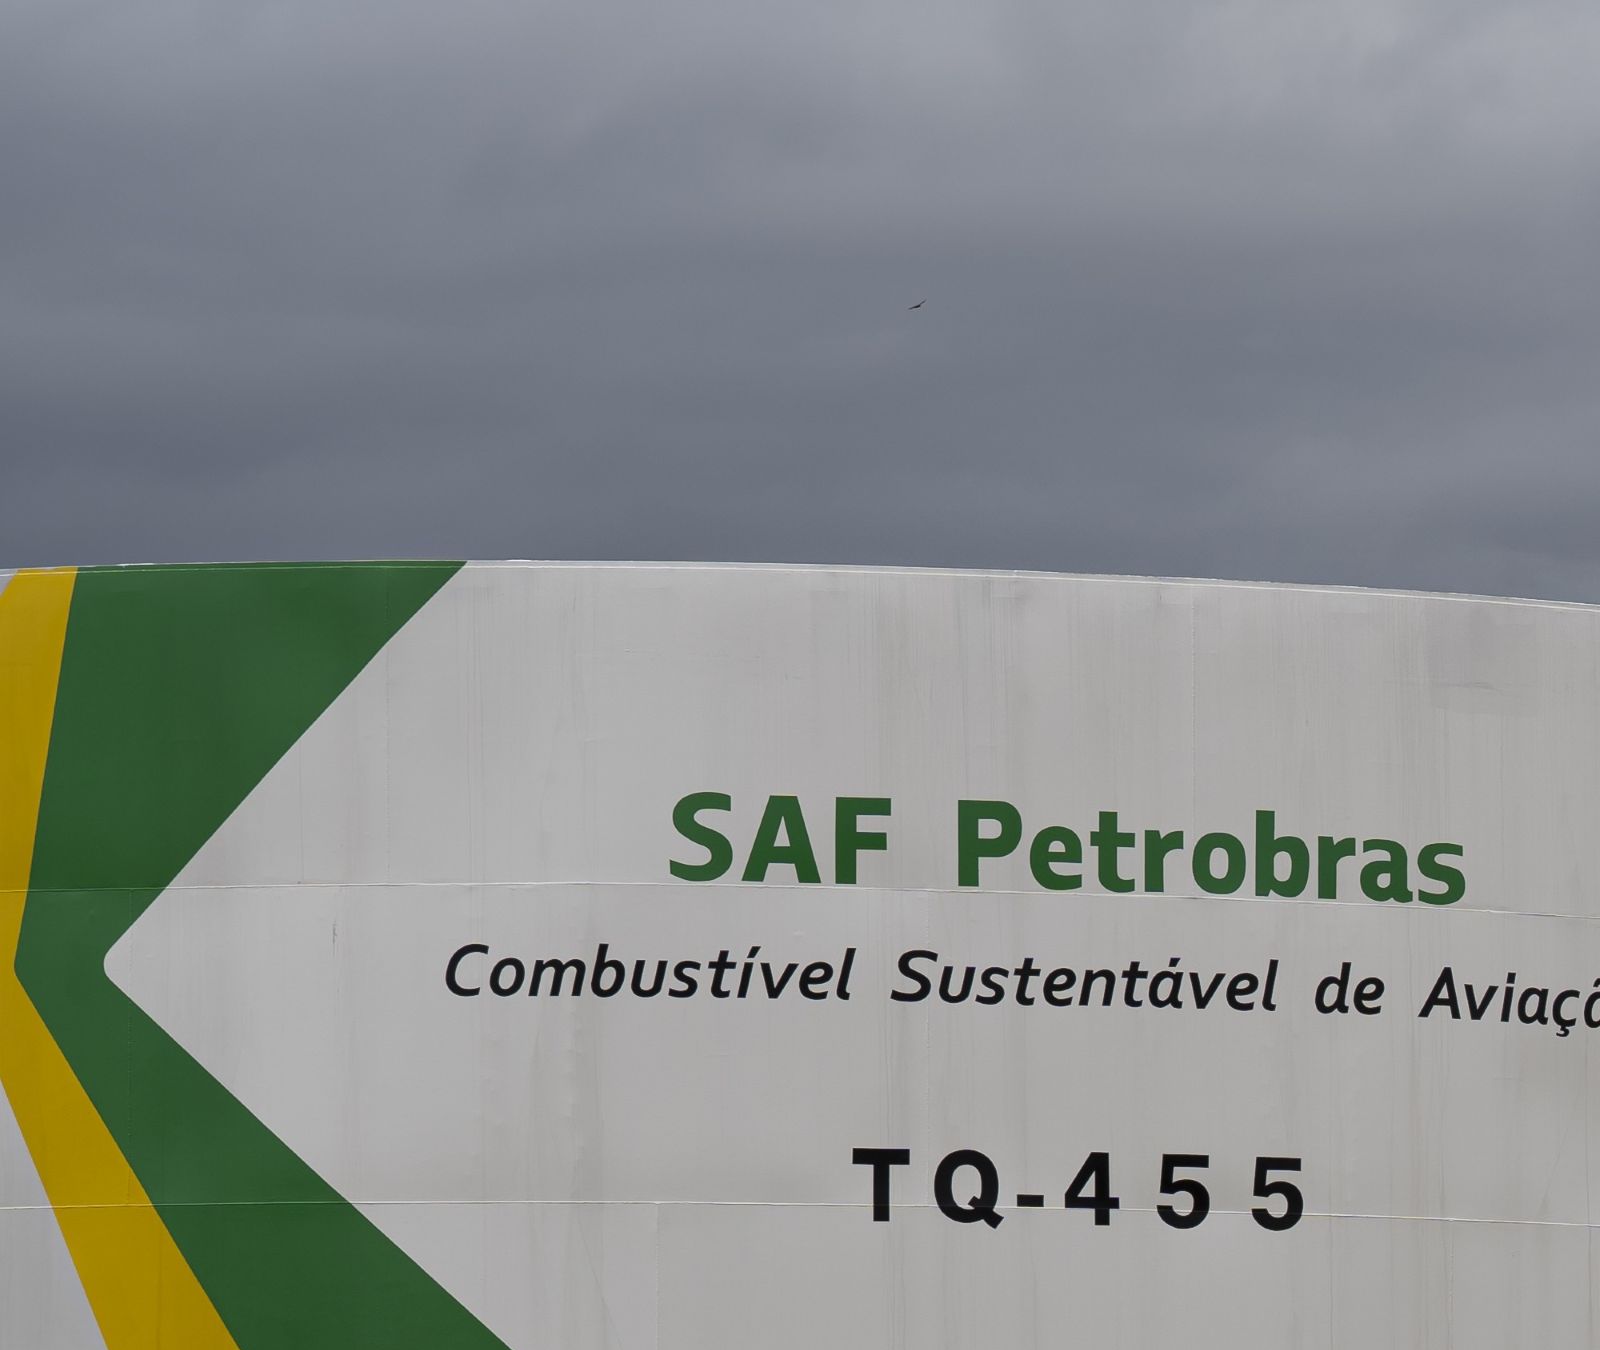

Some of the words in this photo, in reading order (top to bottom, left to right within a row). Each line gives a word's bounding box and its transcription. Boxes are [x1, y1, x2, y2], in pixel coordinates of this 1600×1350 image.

[669, 791, 893, 886] SAF
[957, 799, 1468, 906] Petrobras
[444, 942, 857, 1002] Combustível
[890, 948, 1280, 1013] Sustentável
[1314, 961, 1385, 1016] de
